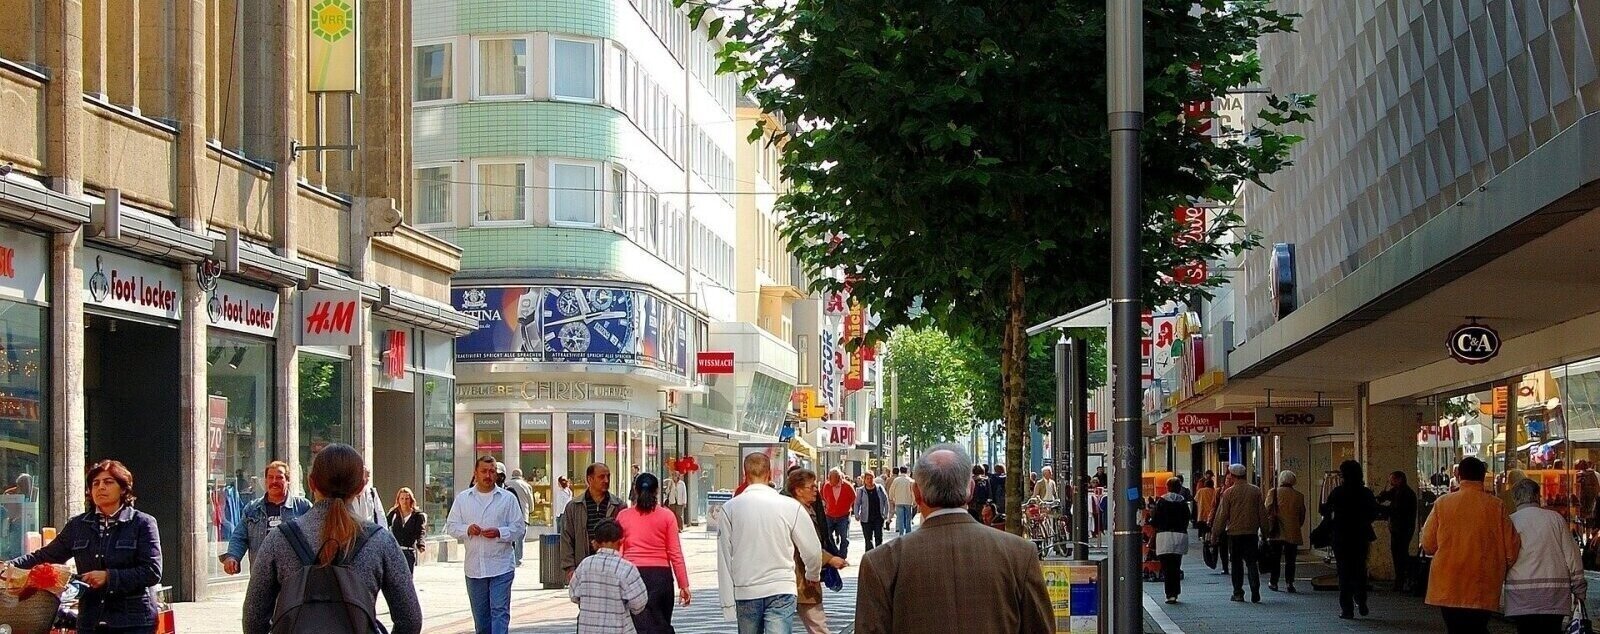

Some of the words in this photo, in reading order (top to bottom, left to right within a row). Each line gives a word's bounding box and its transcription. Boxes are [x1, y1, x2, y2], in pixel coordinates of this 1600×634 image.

[320, 15, 344, 24] VRR
[111, 270, 136, 303] Foot
[140, 277, 176, 311] Locker
[223, 295, 242, 324] Foot
[246, 300, 274, 331] Locker
[306, 301, 355, 334] H&M
[1457, 333, 1492, 352] C&A
[699, 359, 733, 367] WISSMACH
[822, 329, 834, 408] ARCOR
[1275, 413, 1315, 425] RENO
[830, 427, 855, 446] APO
[1237, 425, 1270, 435] RENO
